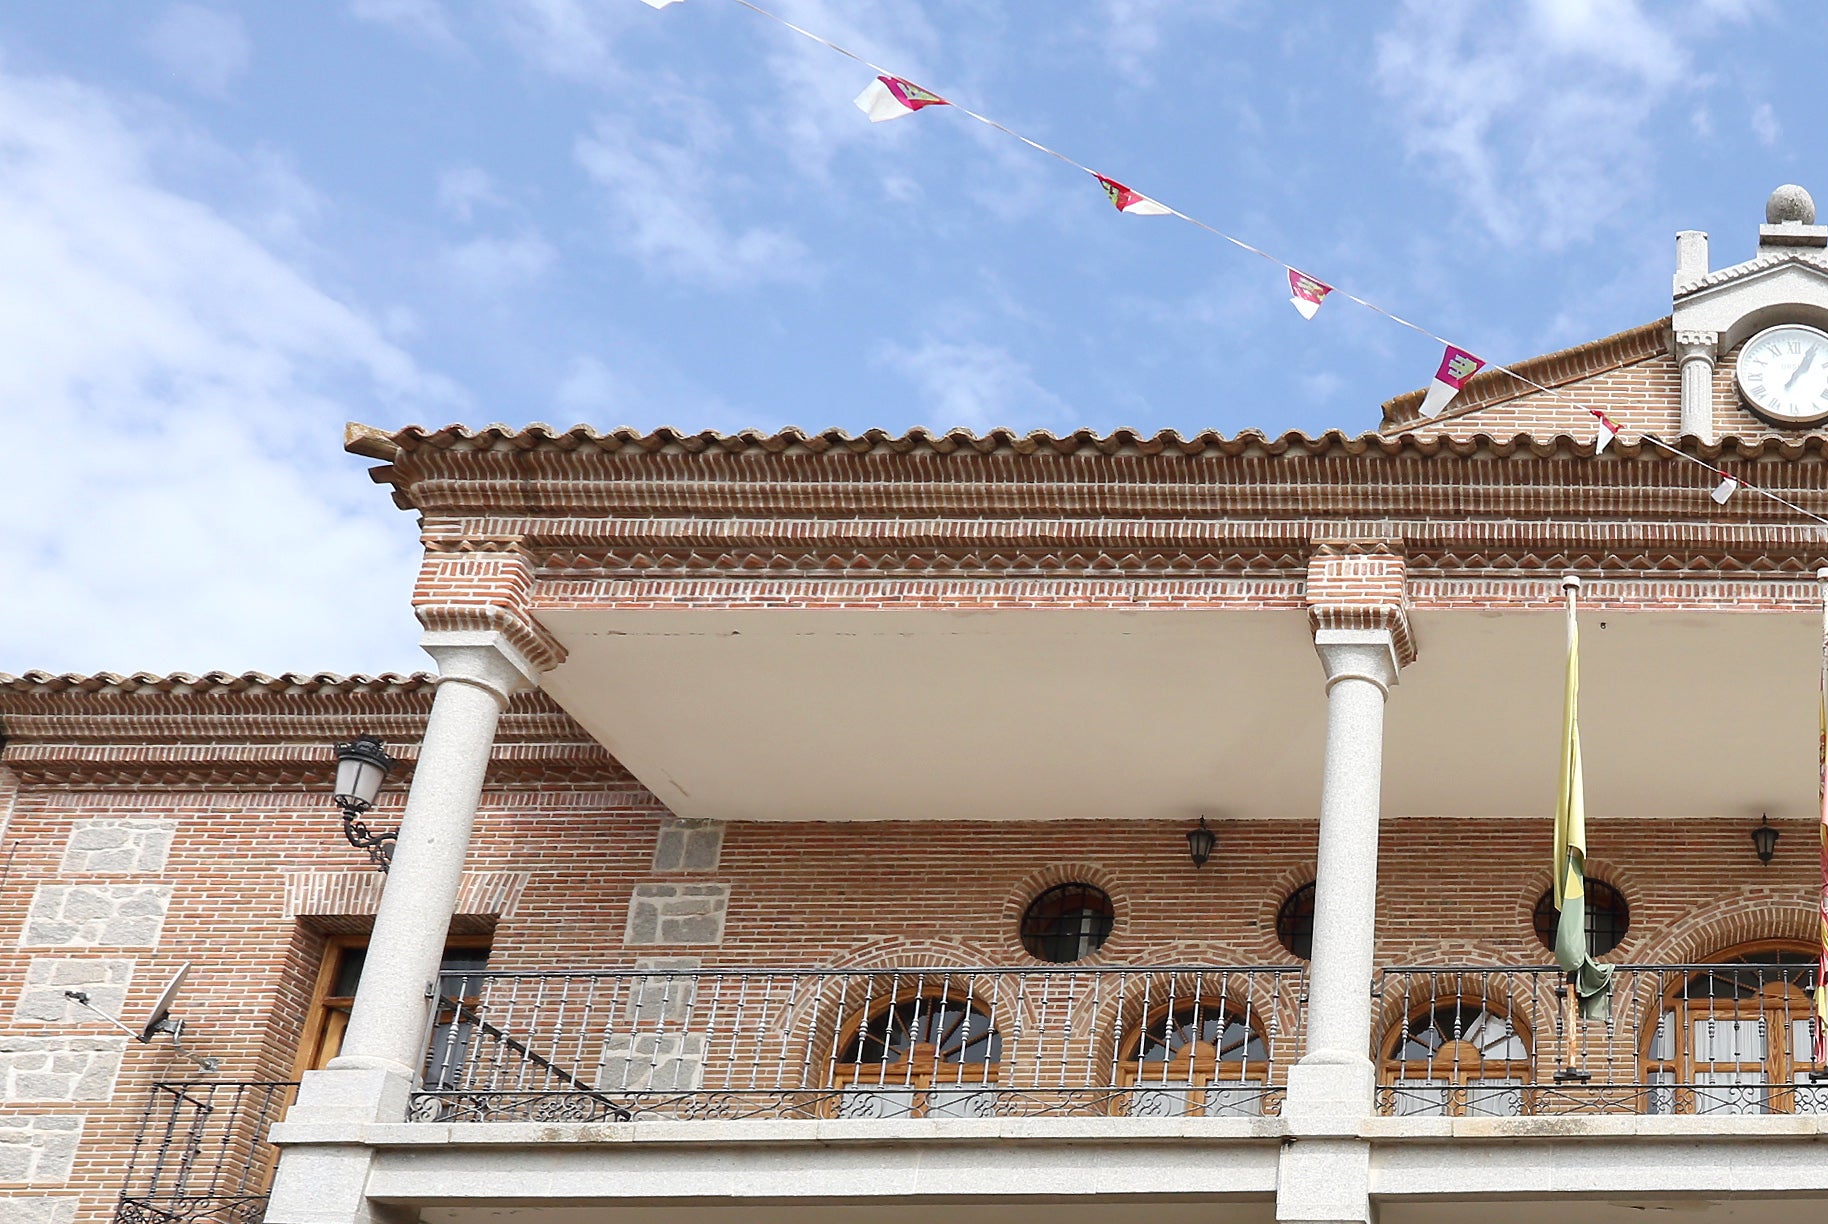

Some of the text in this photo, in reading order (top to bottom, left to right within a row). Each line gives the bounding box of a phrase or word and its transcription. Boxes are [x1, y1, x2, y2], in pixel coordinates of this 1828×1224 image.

[1766, 344, 1782, 358] XI
[1787, 341, 1801, 354] XII
[1753, 357, 1768, 367] X
[1748, 373, 1763, 381] IX
